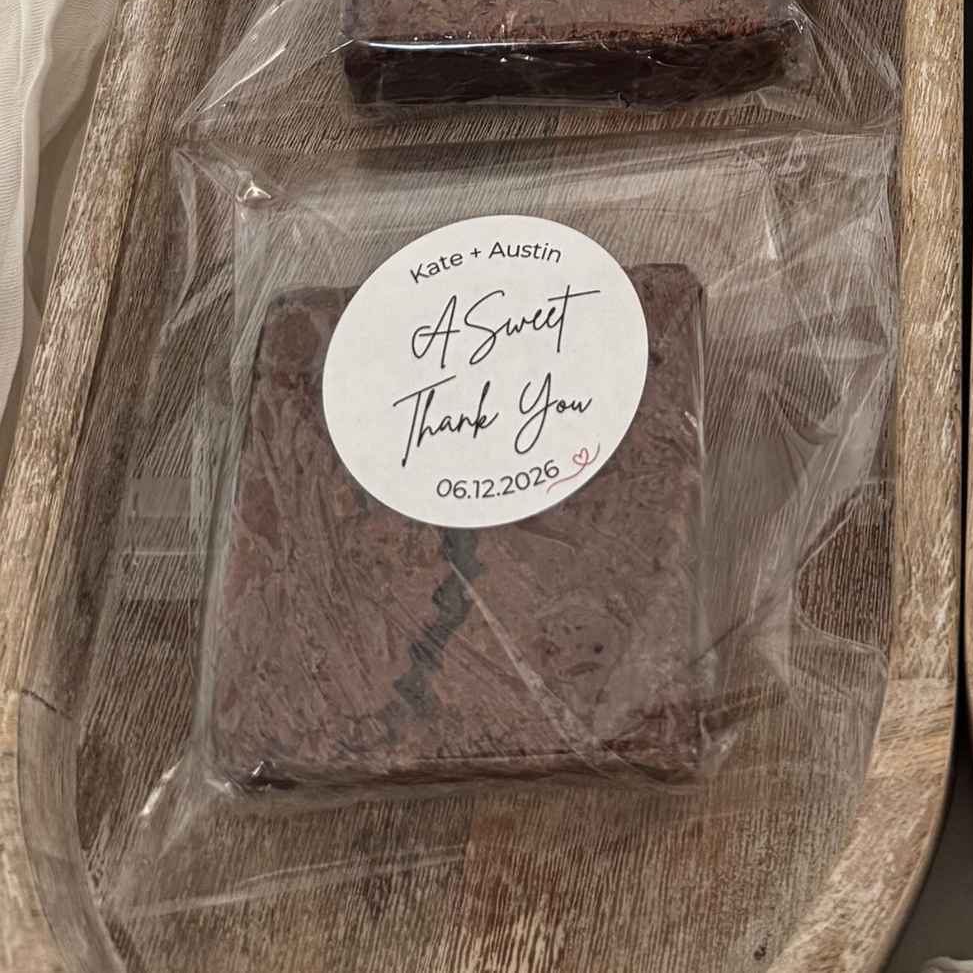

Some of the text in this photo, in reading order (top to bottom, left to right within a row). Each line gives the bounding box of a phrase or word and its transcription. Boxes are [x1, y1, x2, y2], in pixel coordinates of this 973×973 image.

[409, 253, 464, 284] Kate
[488, 241, 563, 264] Austin
[411, 285, 601, 369] A Sweet
[393, 373, 594, 468] Thank You
[436, 459, 559, 500] 06.12.2026
